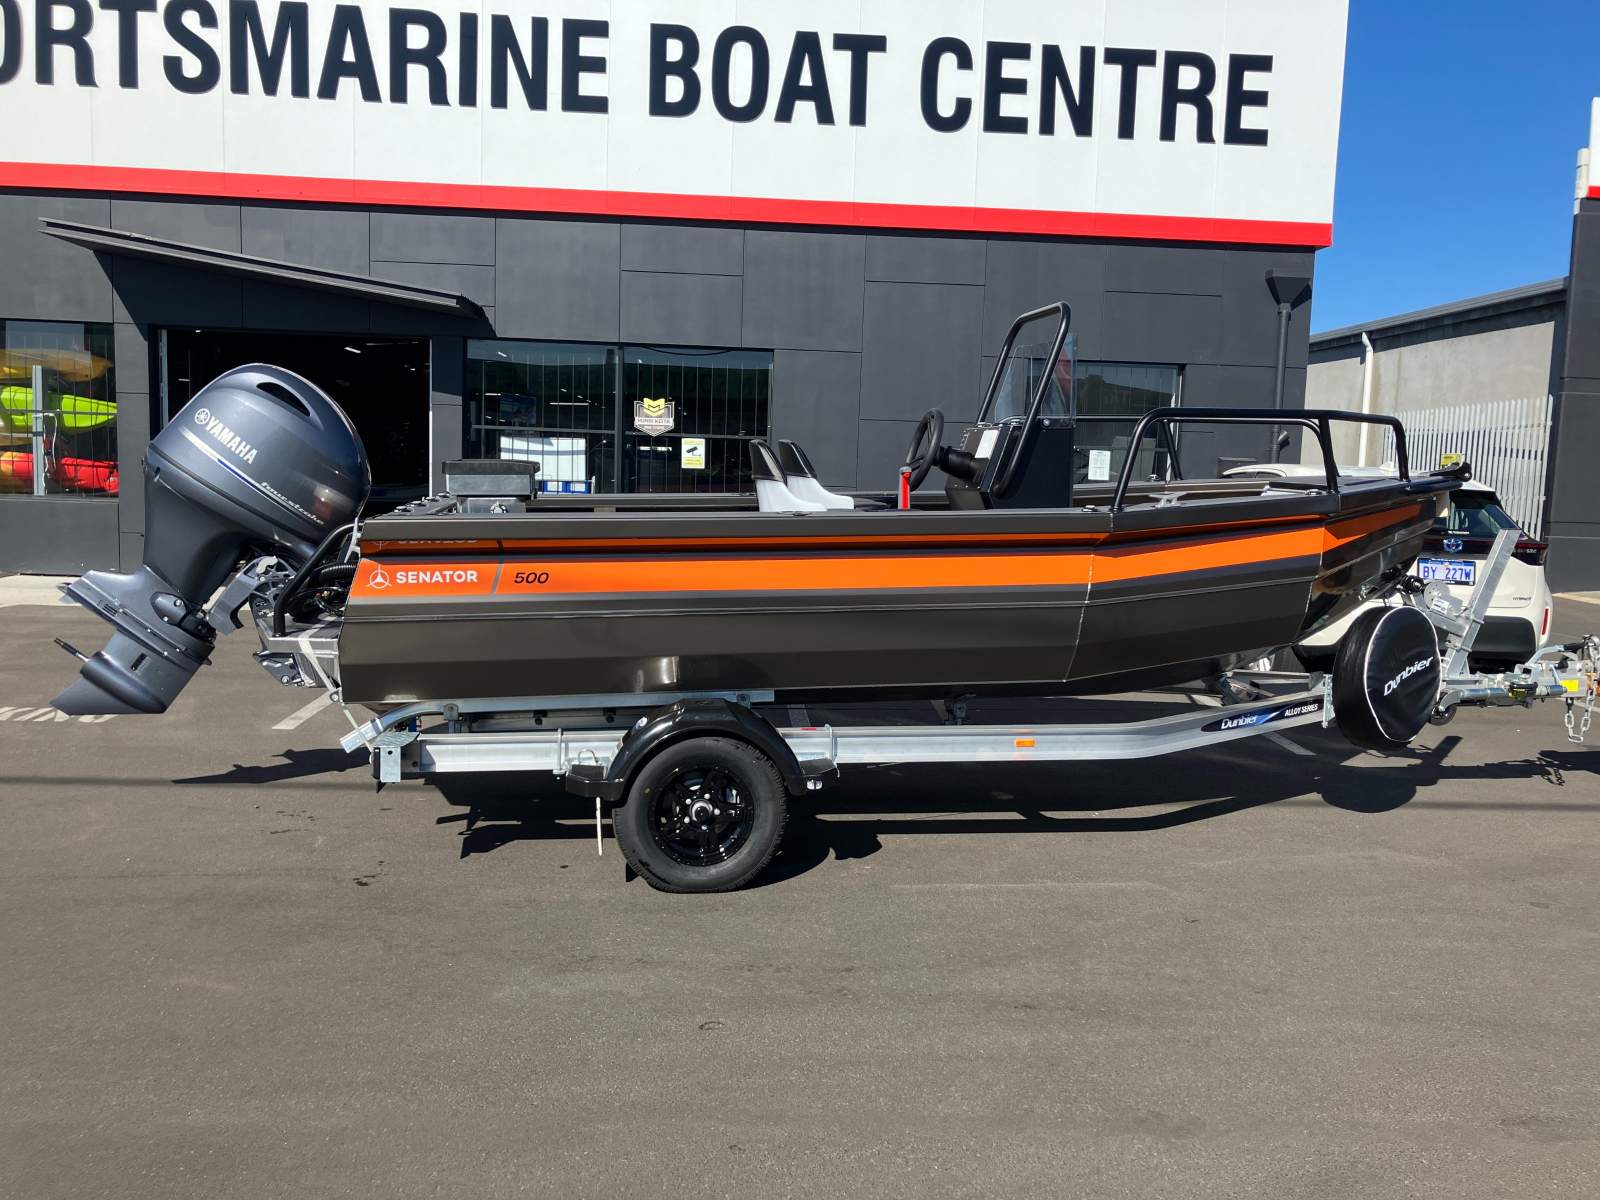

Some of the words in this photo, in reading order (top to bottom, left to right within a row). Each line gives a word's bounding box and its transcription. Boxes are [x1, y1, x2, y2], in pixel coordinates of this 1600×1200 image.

[649, 23, 887, 127] BOAT
[920, 37, 1273, 147] CENTRE
[205, 416, 258, 465] YAMAHA
[395, 570, 478, 584] SENATOR
[513, 571, 549, 584] 500
[1423, 566, 1437, 579] BY
[1445, 567, 1472, 581] 227W
[1383, 656, 1433, 697] Dunbier
[1220, 714, 1258, 729] Dunbier
[1284, 708, 1301, 717] ALLOY
[1301, 703, 1319, 714] SERIES
